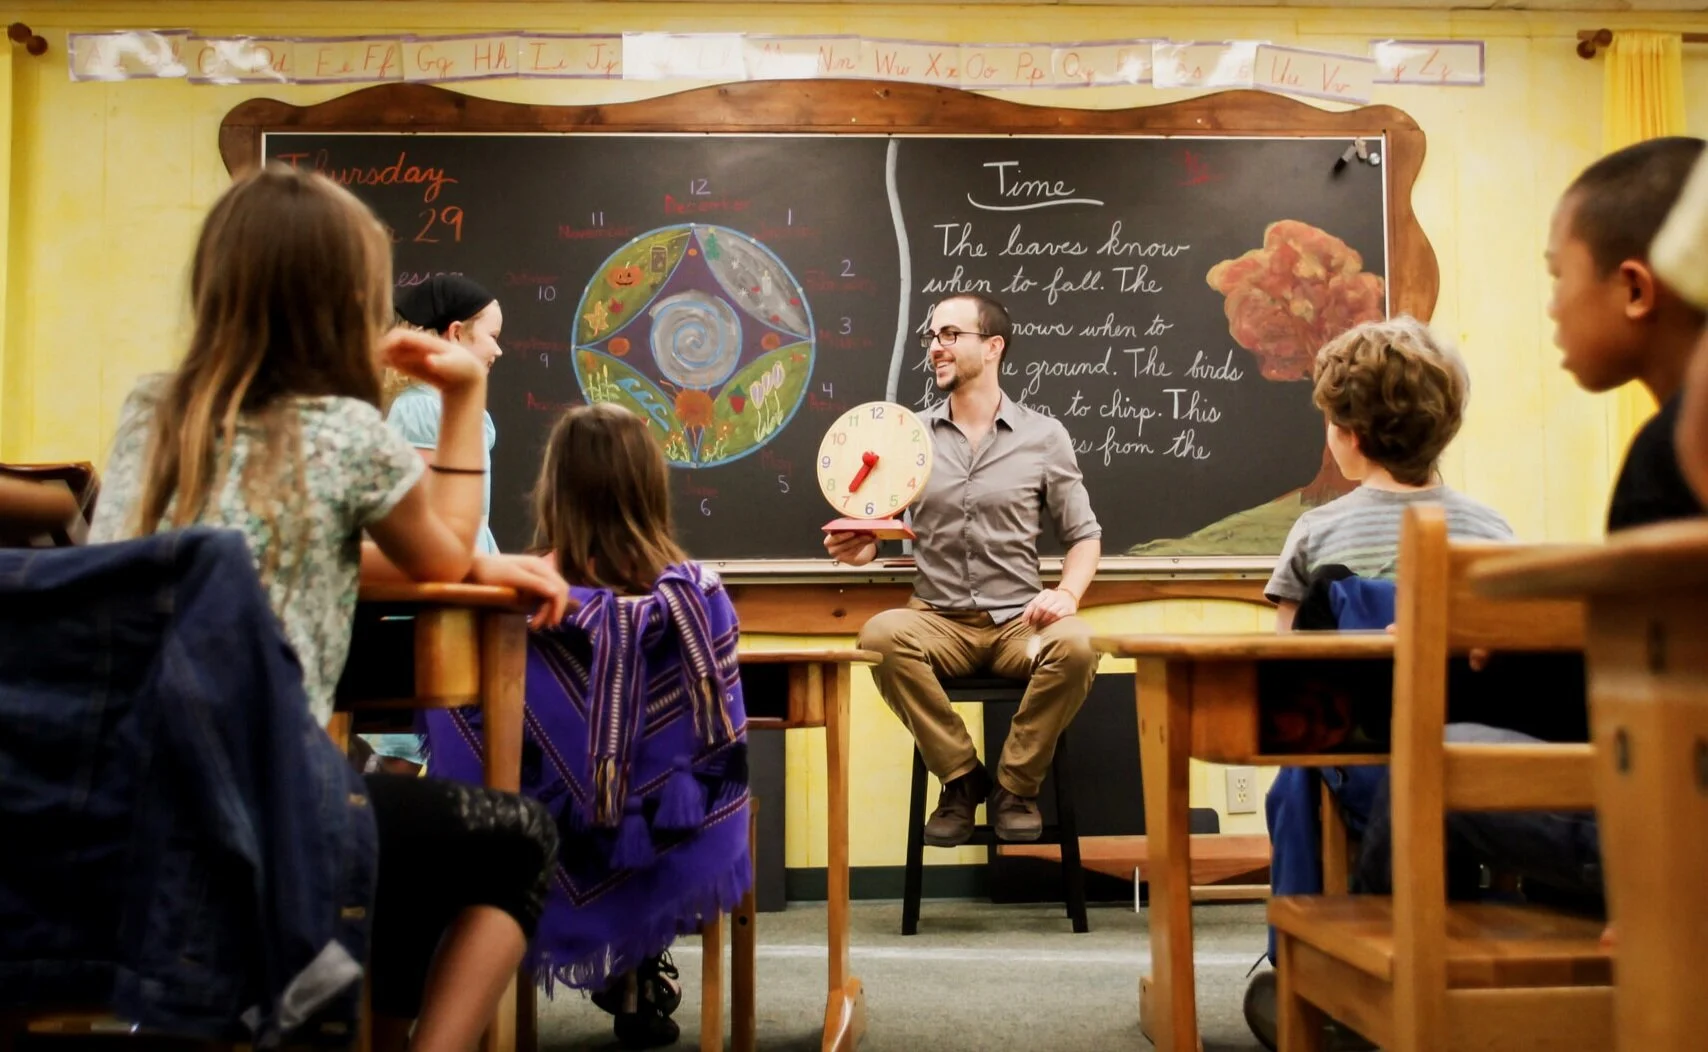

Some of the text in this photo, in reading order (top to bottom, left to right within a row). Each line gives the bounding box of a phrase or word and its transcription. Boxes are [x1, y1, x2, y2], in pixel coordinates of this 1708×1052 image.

[363, 44, 396, 80] Ff
[417, 44, 455, 79] Gg
[474, 44, 512, 71] Hh
[586, 43, 619, 75] Jj
[816, 45, 856, 73] Nn
[875, 50, 911, 76] Ww
[925, 52, 959, 79] Xx
[966, 53, 999, 80] Oo
[1015, 52, 1045, 87] Pp
[690, 178, 711, 195] 12
[982, 160, 1076, 197] Time
[414, 206, 464, 243] 29
[591, 211, 604, 227] 11
[787, 208, 792, 226] 1
[934, 220, 1191, 257] The leaves know
[840, 259, 856, 277] 2
[538, 285, 557, 301] 10
[922, 264, 1163, 306] when to fall. The
[839, 317, 853, 335] 3
[1009, 312, 1174, 338] nows when to
[539, 352, 550, 369] 9
[1025, 347, 1118, 395] ground.
[1123, 346, 1173, 378] The
[1184, 348, 1245, 382] birds
[822, 382, 833, 399] 4
[869, 406, 885, 420] 12
[898, 413, 905, 426] 1
[1015, 388, 1222, 437] hen to chirp. This
[848, 415, 860, 428] 11
[832, 432, 847, 446] 10
[912, 430, 921, 442] 2
[1098, 425, 1155, 467] from
[1163, 428, 1212, 460] the
[821, 456, 831, 468] 9
[916, 453, 926, 466] 3
[778, 474, 790, 494] 5
[826, 478, 836, 492] 8
[907, 477, 916, 490] 4
[700, 498, 711, 516] 6
[841, 495, 851, 508] 7
[865, 502, 875, 516] 6
[889, 494, 899, 508] 5
